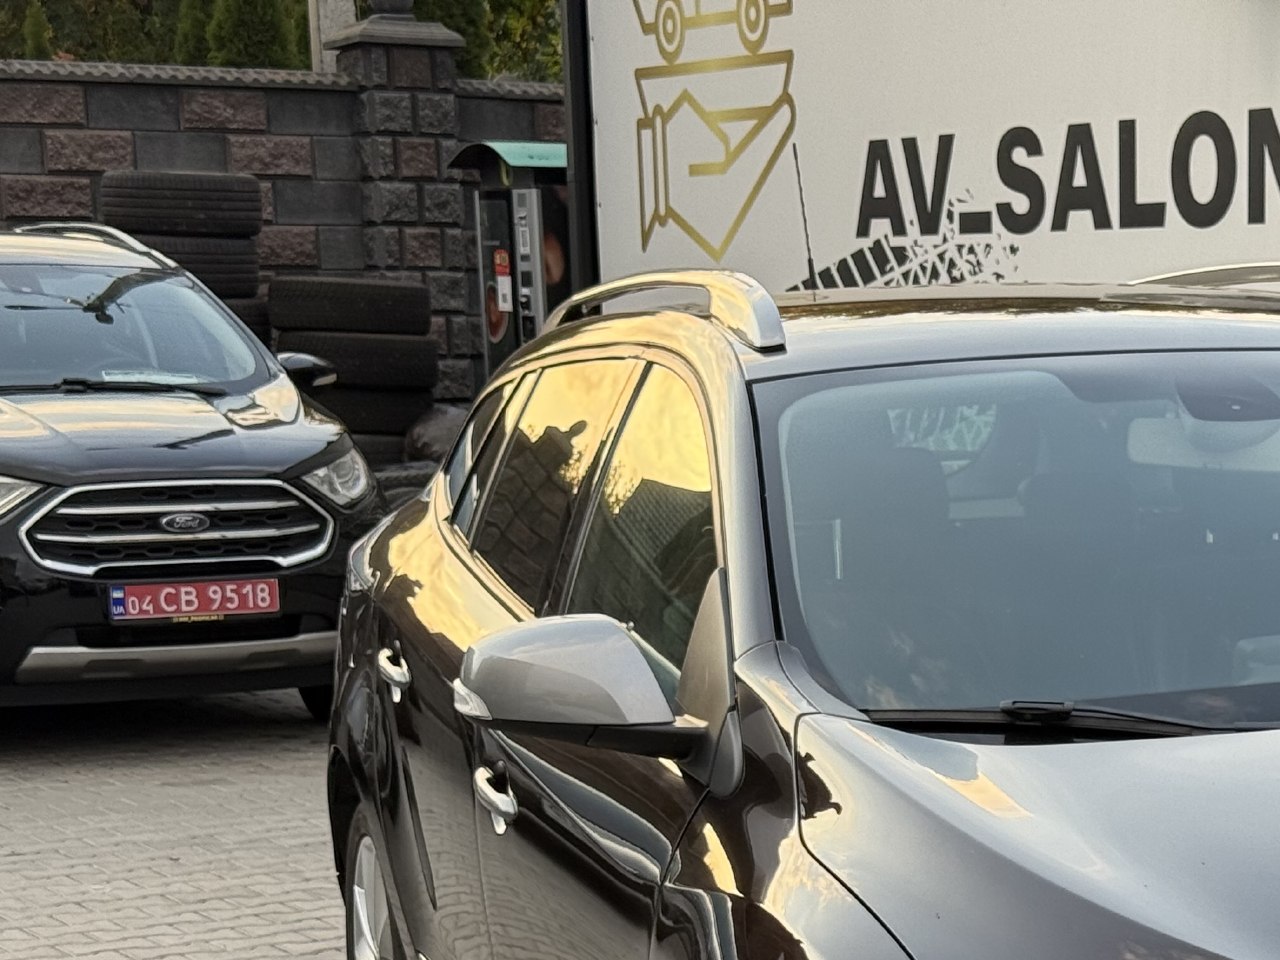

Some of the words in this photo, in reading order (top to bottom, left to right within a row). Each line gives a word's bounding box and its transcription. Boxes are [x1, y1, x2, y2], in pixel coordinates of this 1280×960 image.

[173, 516, 200, 529] Ford
[128, 596, 154, 615] 04
[160, 587, 199, 612] CB
[208, 583, 271, 610] 9518
[113, 605, 125, 615] UA
